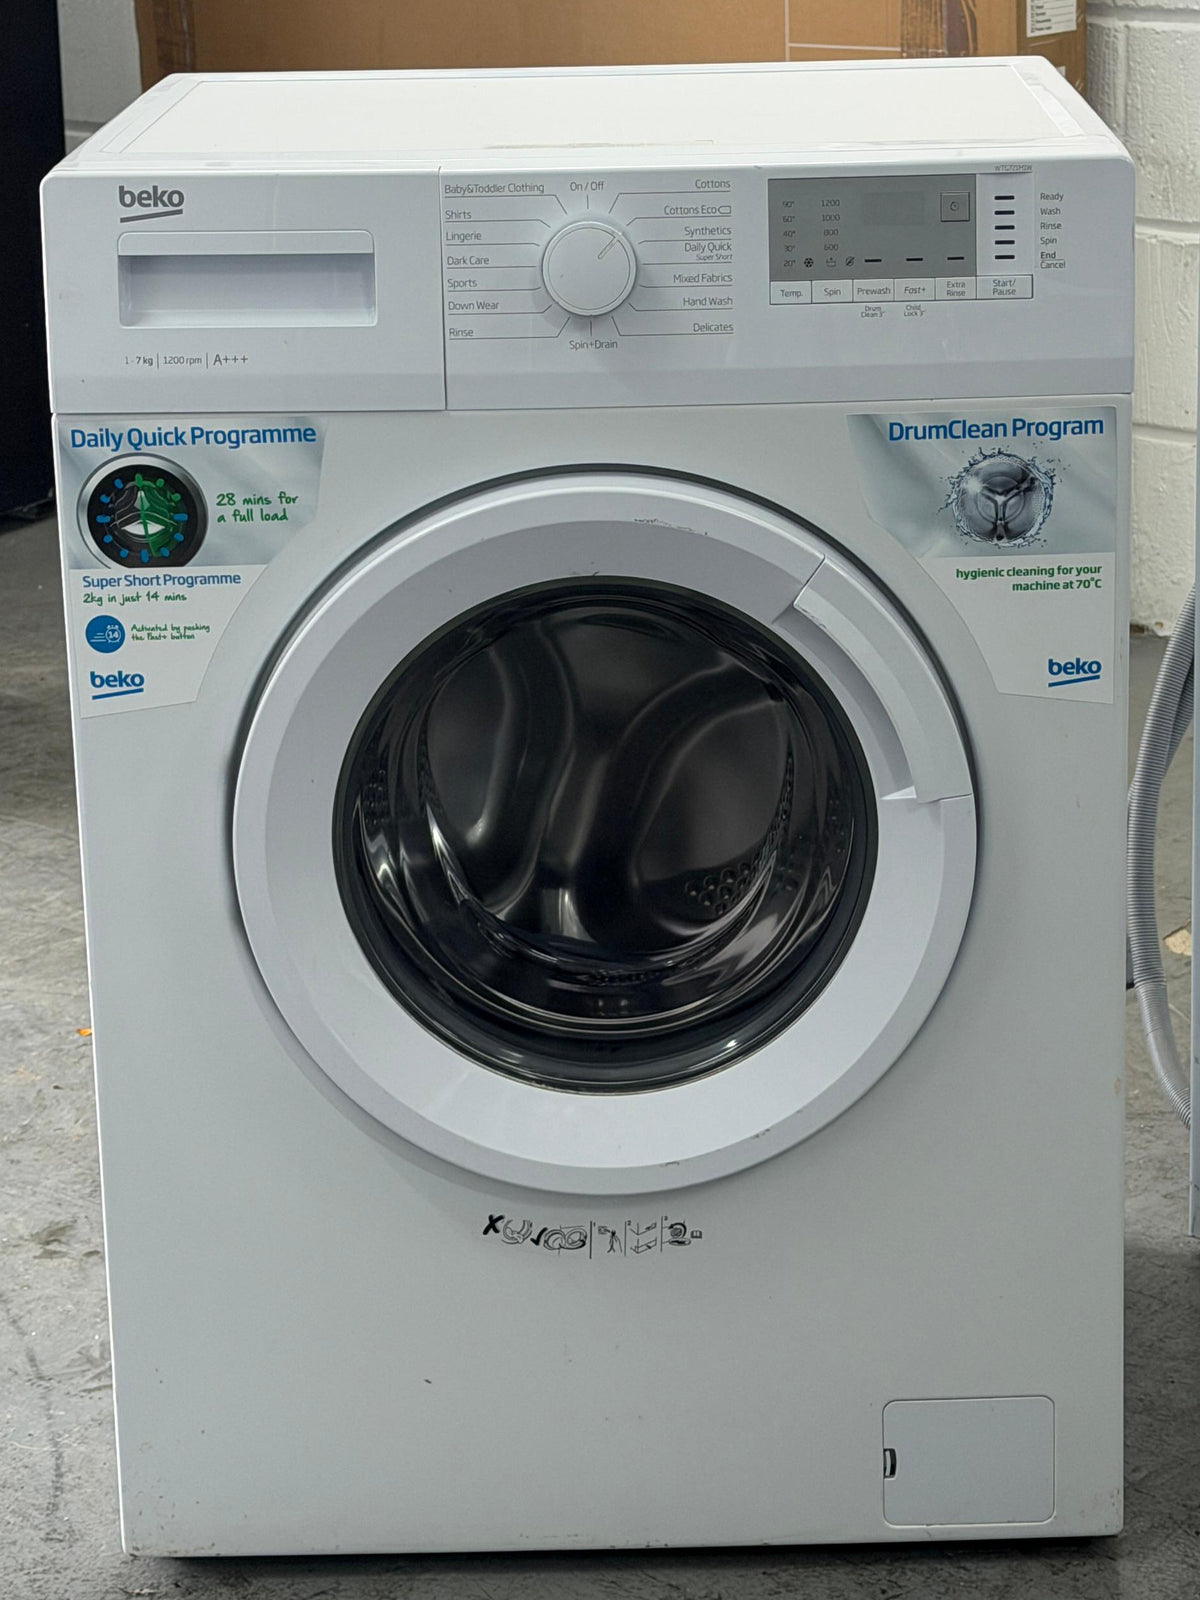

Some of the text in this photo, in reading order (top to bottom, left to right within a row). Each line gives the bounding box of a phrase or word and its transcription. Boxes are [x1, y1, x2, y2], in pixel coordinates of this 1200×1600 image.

[444, 183, 544, 194] Baby&Toddler Clothing
[570, 182, 582, 191] On
[591, 181, 604, 190] Off
[695, 179, 730, 188] Cottons
[118, 185, 184, 207] beko
[1040, 192, 1064, 202] Ready
[446, 210, 472, 219] Shirts
[664, 206, 717, 215] Cottons Eco
[684, 226, 732, 236] Synthetics
[446, 231, 482, 242] Lingerie
[1040, 237, 1057, 246] Spin
[685, 242, 732, 254] Daily Quick
[447, 256, 489, 265] Dark Care
[1040, 261, 1065, 269] Cancel
[674, 273, 732, 282] Mixed Fabrics
[448, 278, 477, 289] Sports
[780, 290, 803, 298] Temp.
[824, 288, 841, 296] Spin
[857, 287, 891, 295] Prewash
[904, 286, 926, 294] Fast+
[448, 301, 498, 310] Down Wear
[683, 296, 733, 306] Hand Wash
[449, 328, 474, 336] Rinse
[693, 322, 734, 332] Delicates
[569, 340, 618, 351] Spin+Drain
[163, 356, 202, 366] 1200 rpm
[213, 354, 248, 365] A+++
[889, 419, 1103, 441] DrumClean Program
[71, 427, 316, 452] Daily Quick Programme
[216, 492, 298, 506] 28 mins for
[217, 510, 288, 523] a full load
[956, 565, 1102, 580] hygienic cleaning for your
[83, 574, 241, 590] Super Short Programme
[1012, 577, 1102, 591] machine at 70°C
[83, 591, 187, 606] 2kg in just 14 mins
[171, 624, 180, 633] by
[1048, 657, 1101, 675] beko
[90, 671, 144, 688] beko
